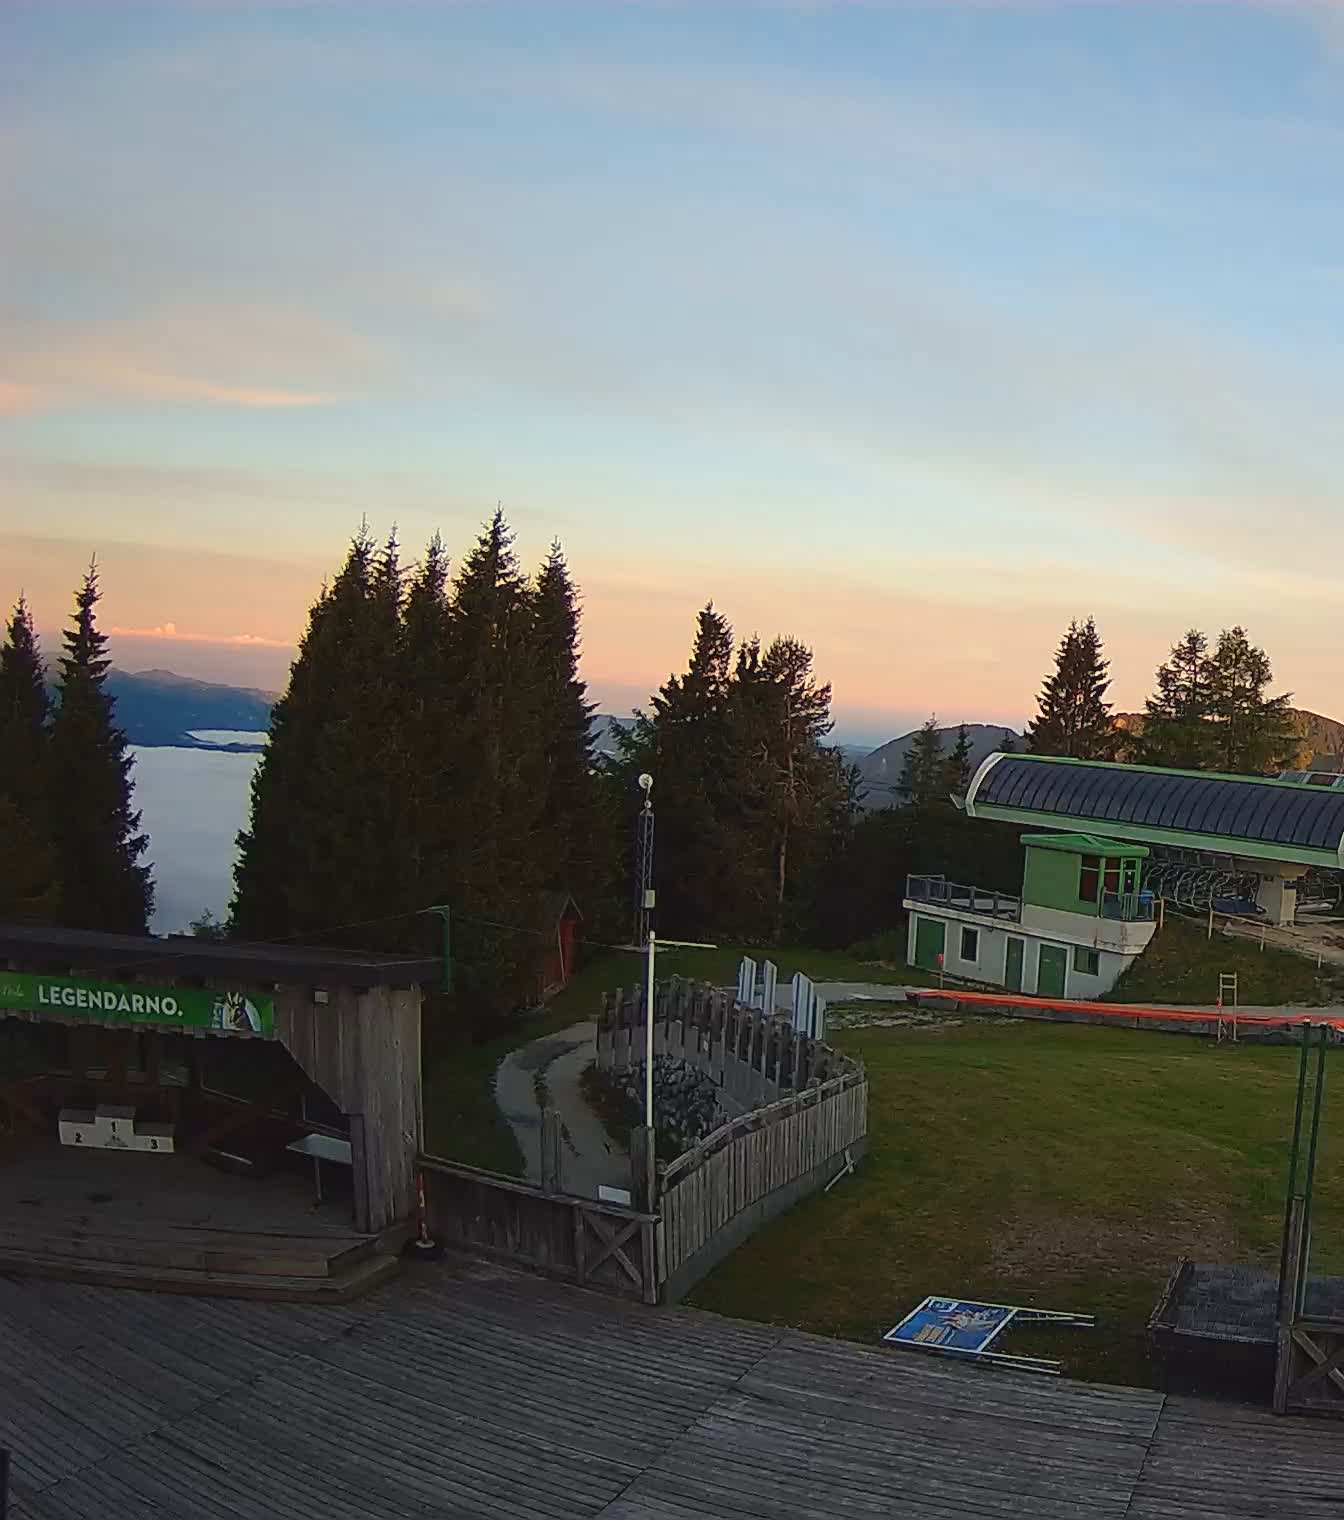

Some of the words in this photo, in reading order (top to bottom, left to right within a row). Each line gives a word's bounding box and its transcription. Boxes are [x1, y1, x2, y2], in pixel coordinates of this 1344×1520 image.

[38, 984, 183, 1017] LEGENDARNO.
[111, 1121, 117, 1133] 1
[75, 1132, 83, 1143] 2
[150, 1139, 159, 1150] 3
